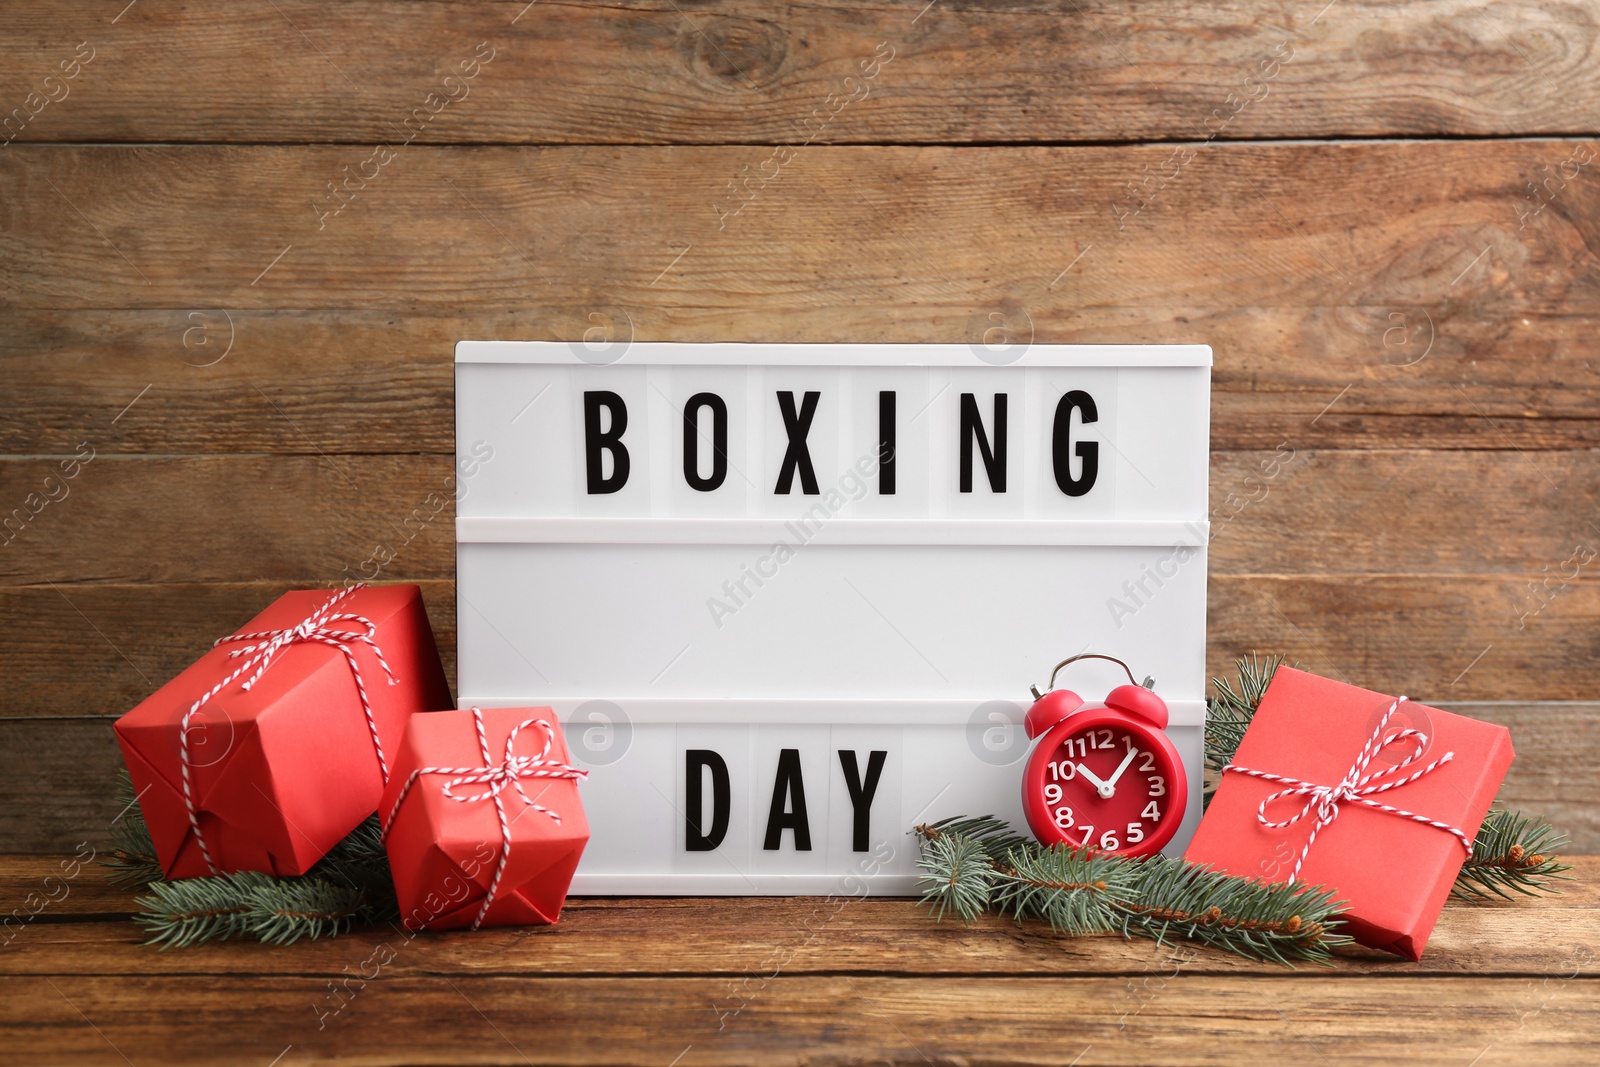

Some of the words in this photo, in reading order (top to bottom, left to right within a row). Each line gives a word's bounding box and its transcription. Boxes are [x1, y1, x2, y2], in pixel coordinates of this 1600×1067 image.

[584, 390, 1098, 496] BOXING
[1064, 738, 1087, 758] 11
[1086, 729, 1115, 750] 12
[1122, 735, 1133, 754] 1
[1047, 760, 1076, 781] 10
[1139, 752, 1156, 772] 2
[1044, 784, 1063, 805] 9
[1148, 776, 1166, 796] 3
[686, 749, 887, 852] DAY
[1141, 800, 1160, 822] 4
[1055, 806, 1074, 828] 8
[1078, 825, 1094, 846] 7
[1100, 830, 1119, 851] 6
[1127, 822, 1144, 843] 5
